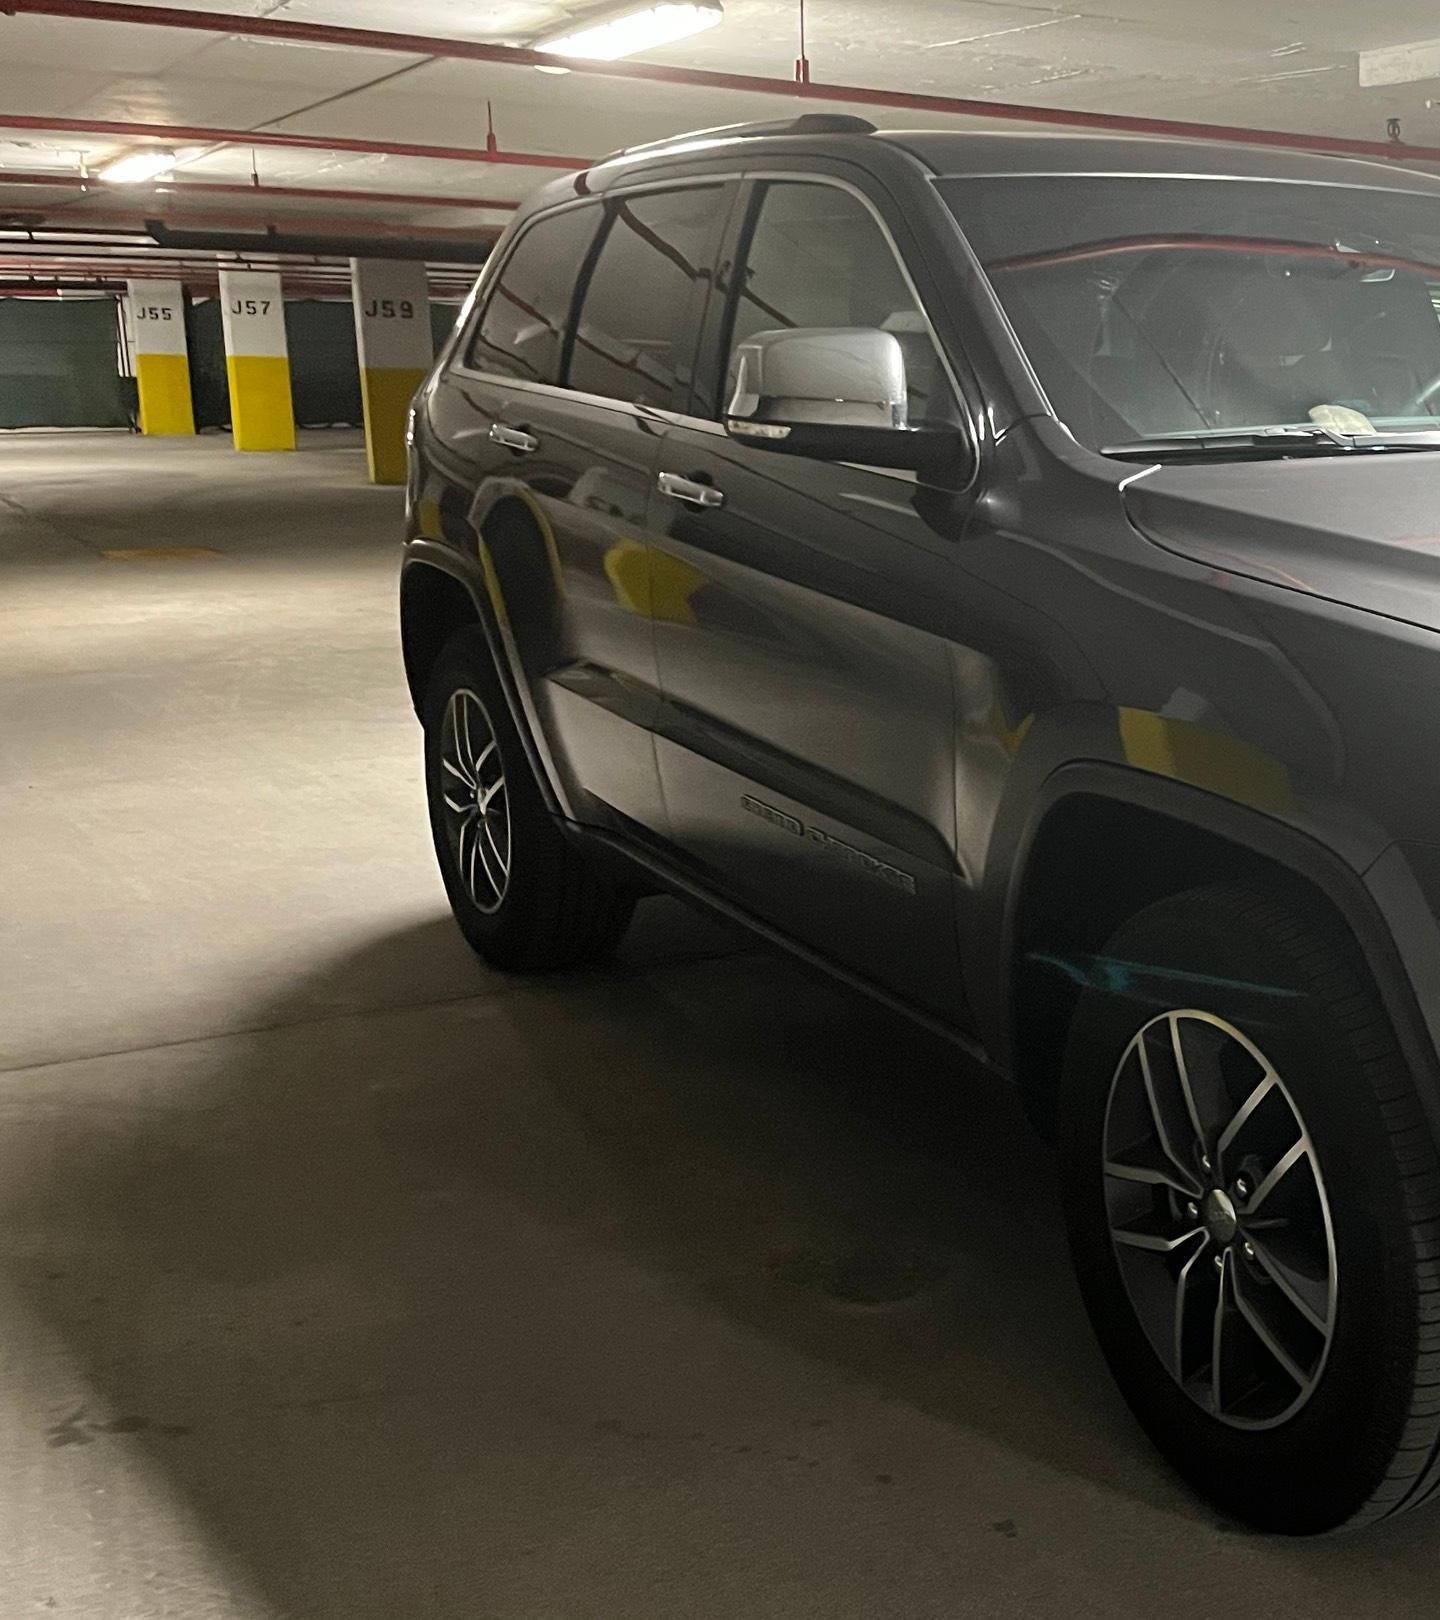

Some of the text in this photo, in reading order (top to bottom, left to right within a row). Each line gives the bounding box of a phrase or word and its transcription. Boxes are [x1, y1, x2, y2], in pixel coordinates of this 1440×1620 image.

[137, 307, 172, 321] J55
[231, 300, 271, 316] J57
[365, 300, 414, 319] J59
